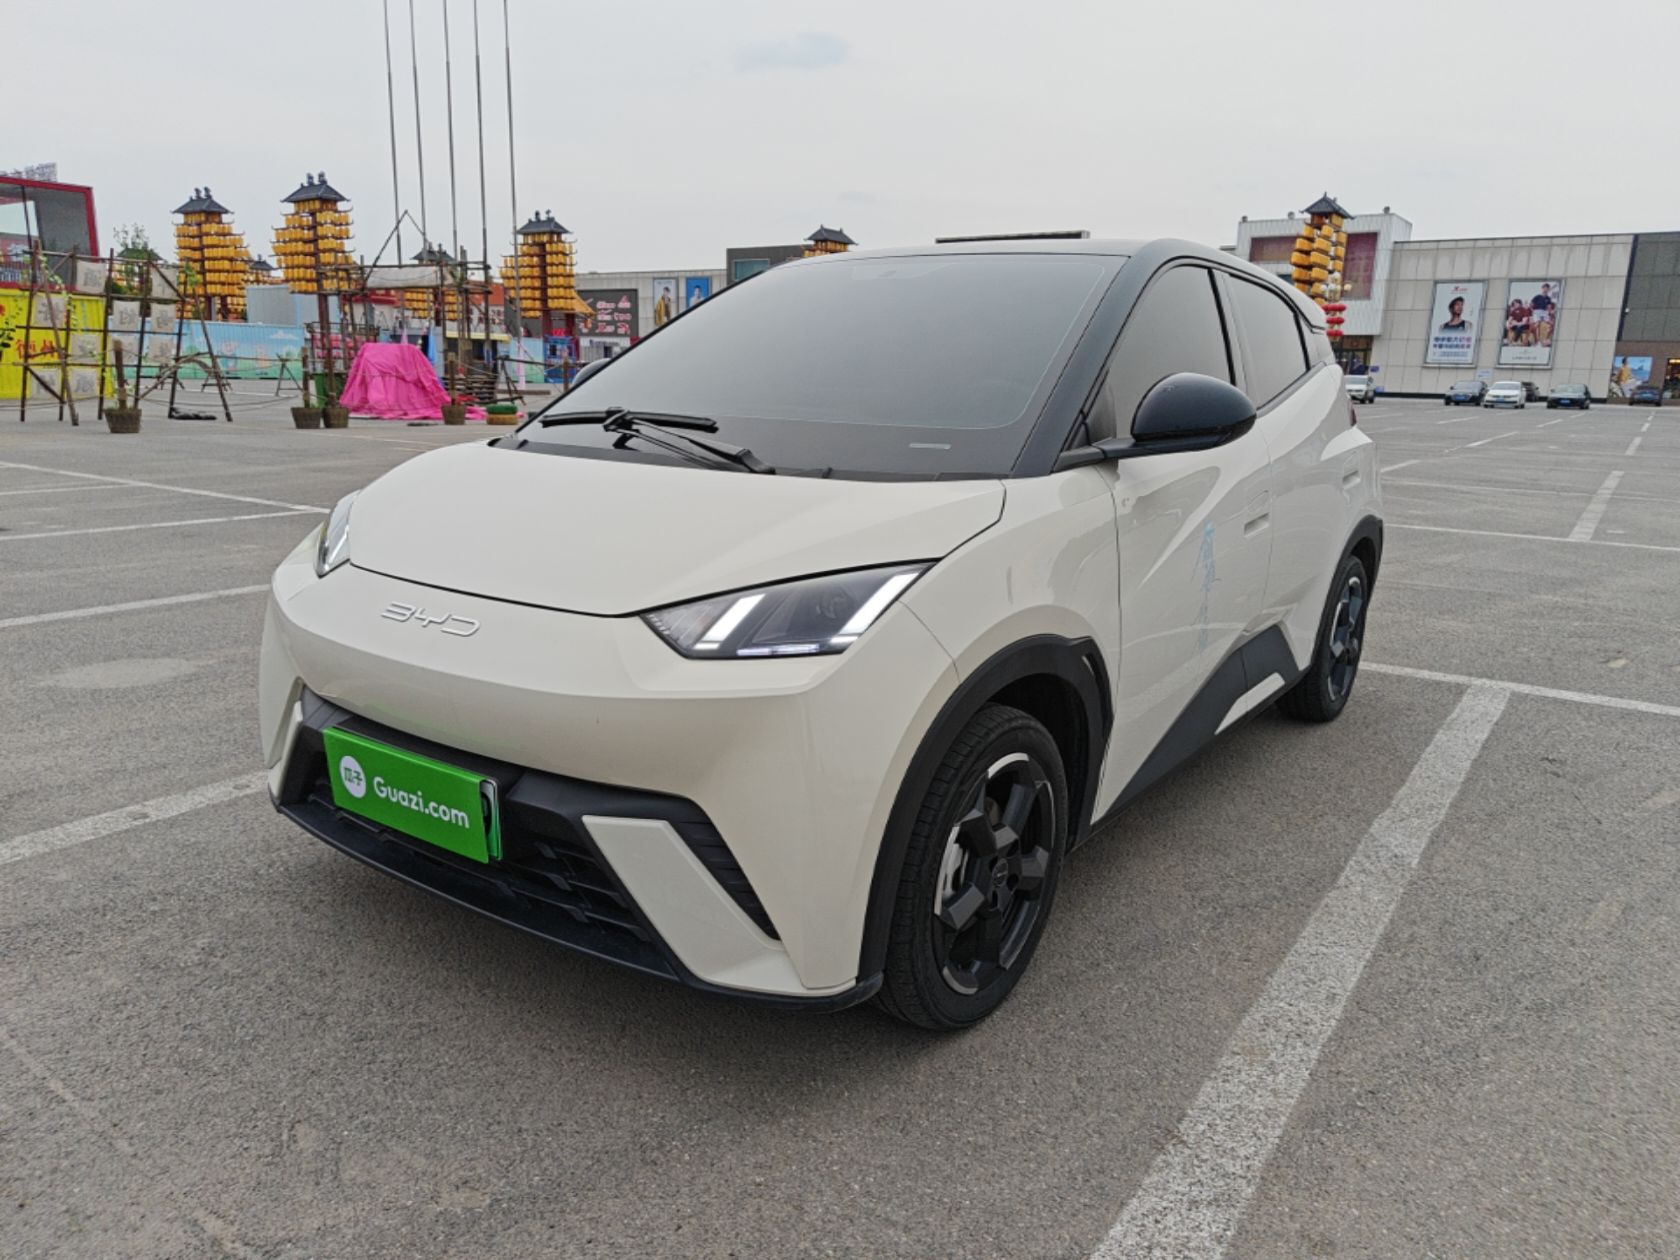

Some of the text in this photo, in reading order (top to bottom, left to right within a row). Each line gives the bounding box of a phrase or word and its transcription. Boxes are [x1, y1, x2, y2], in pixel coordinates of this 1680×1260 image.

[381, 601, 481, 637] BYD
[343, 766, 363, 788] 瓜子
[373, 776, 470, 829] Guazi.com
